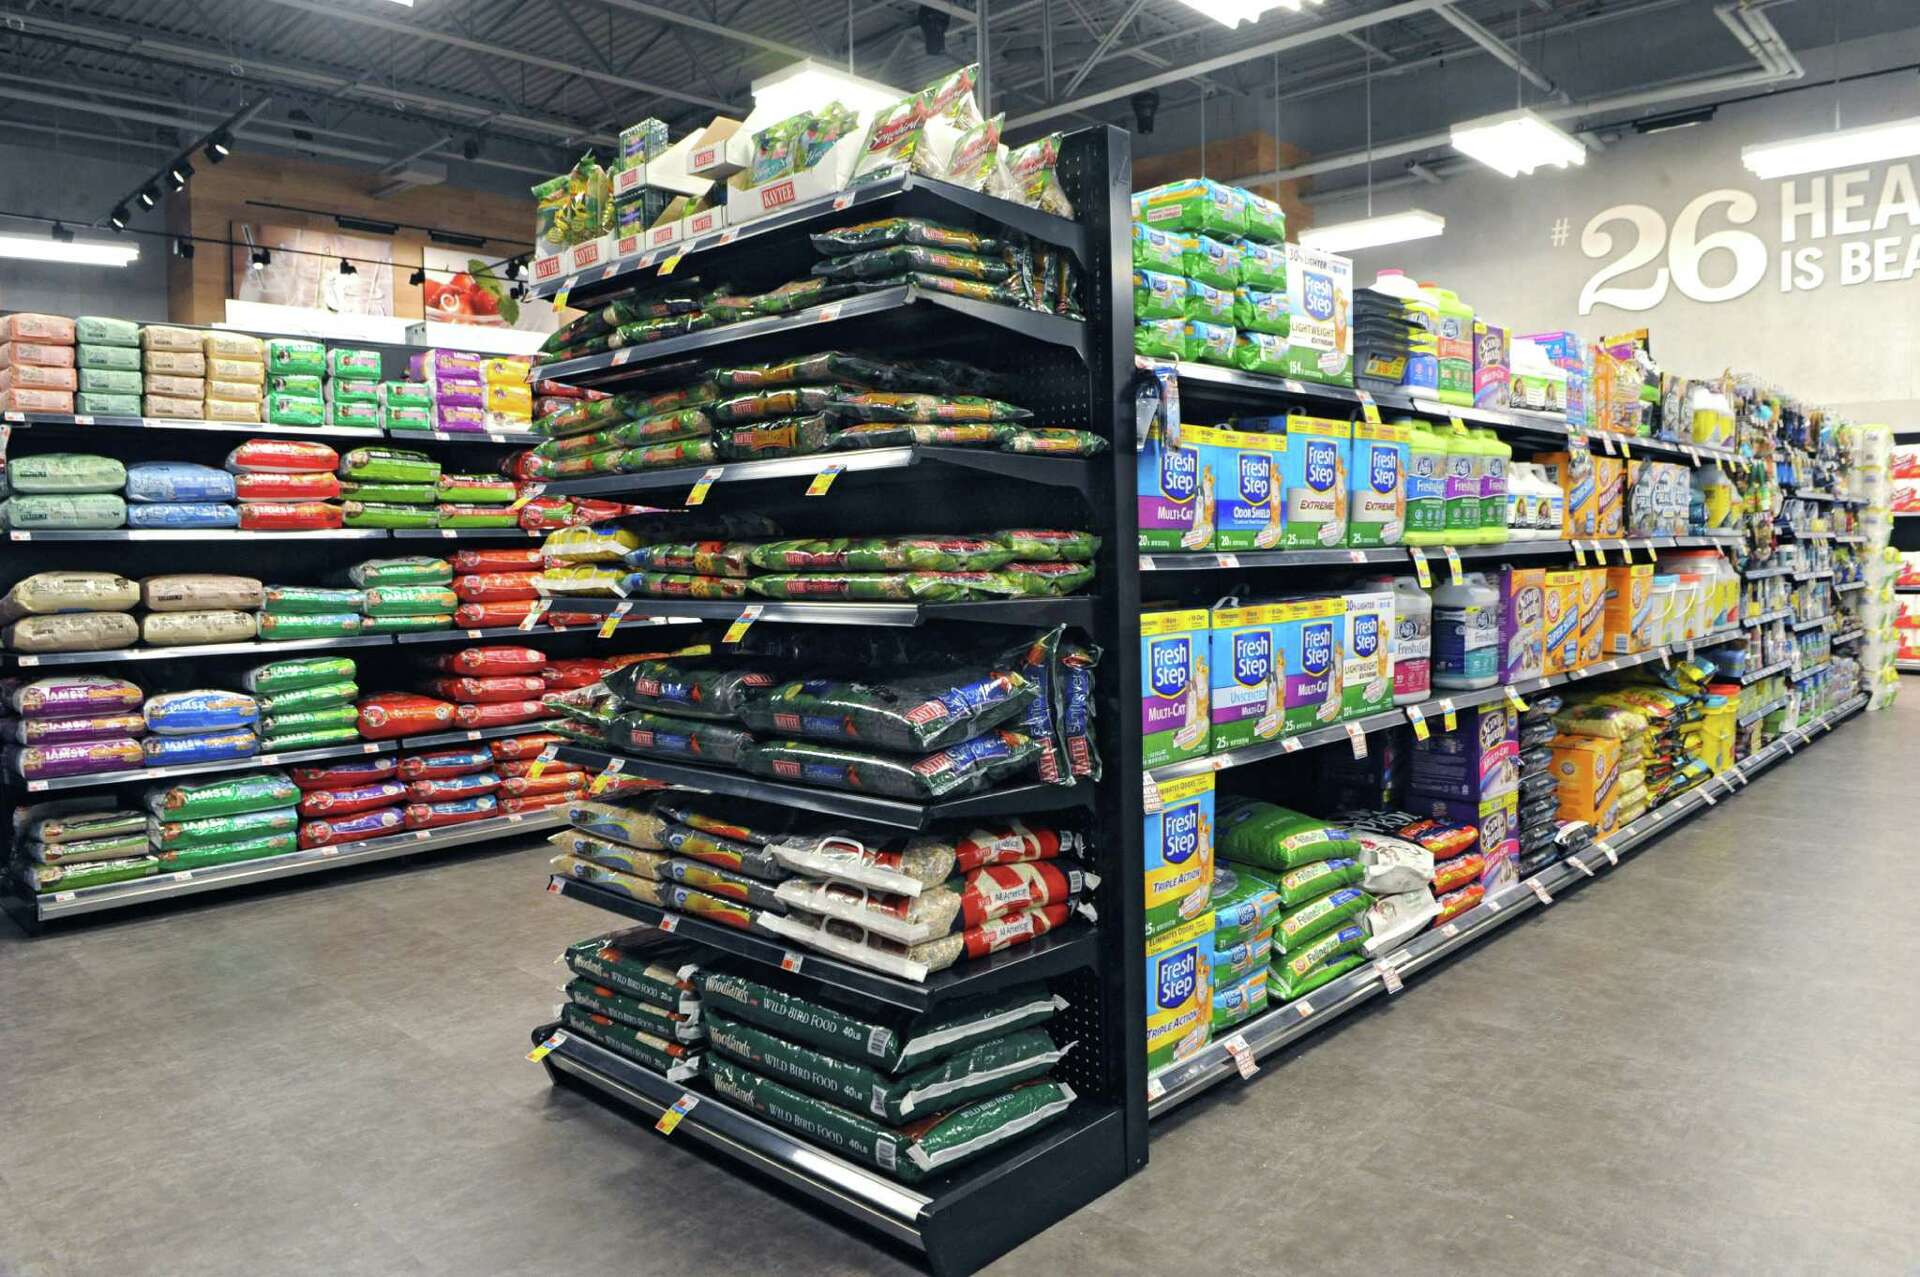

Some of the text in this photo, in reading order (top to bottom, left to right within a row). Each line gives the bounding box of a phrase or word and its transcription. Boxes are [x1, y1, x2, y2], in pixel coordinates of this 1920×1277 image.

[763, 184, 793, 205] KAYTEE
[1780, 247, 1825, 293] IS
[1306, 275, 1331, 296] Fresh
[1306, 294, 1331, 316] Step
[1309, 447, 1334, 464] Fresh
[1374, 453, 1396, 468] Fresh
[1242, 459, 1268, 476] Fresh
[1310, 466, 1334, 485] Step
[1166, 472, 1193, 493] Step
[1243, 478, 1268, 496] Step
[1374, 470, 1395, 488] Step
[1300, 500, 1334, 510] EXTREME
[1365, 501, 1395, 511] EXTREME
[1356, 618, 1377, 635] Fresh
[1237, 637, 1268, 658] Fresh
[1305, 629, 1331, 647] Fresh
[1356, 637, 1376, 651] Step
[1154, 645, 1186, 667] Fresh
[1306, 649, 1329, 666] Step
[1155, 667, 1186, 687] Step
[1239, 659, 1267, 677] Step
[1165, 810, 1196, 837] Fresh
[1166, 834, 1195, 857] Step
[1161, 954, 1193, 984] Fresh
[706, 975, 748, 1004] Woodlands
[1162, 977, 1192, 1002] Step
[763, 997, 787, 1017] WILD
[788, 1007, 809, 1024] BIRD
[811, 1014, 837, 1033] FOOD
[709, 1026, 751, 1058] Woodlands
[765, 1053, 787, 1073] WILD
[789, 1063, 810, 1081] BIRD
[811, 1072, 838, 1092] FOOD
[713, 1072, 755, 1104] Woodlands
[769, 1103, 793, 1123] WILD
[794, 1114, 815, 1133] BIRD
[817, 1123, 843, 1145] FOOD
